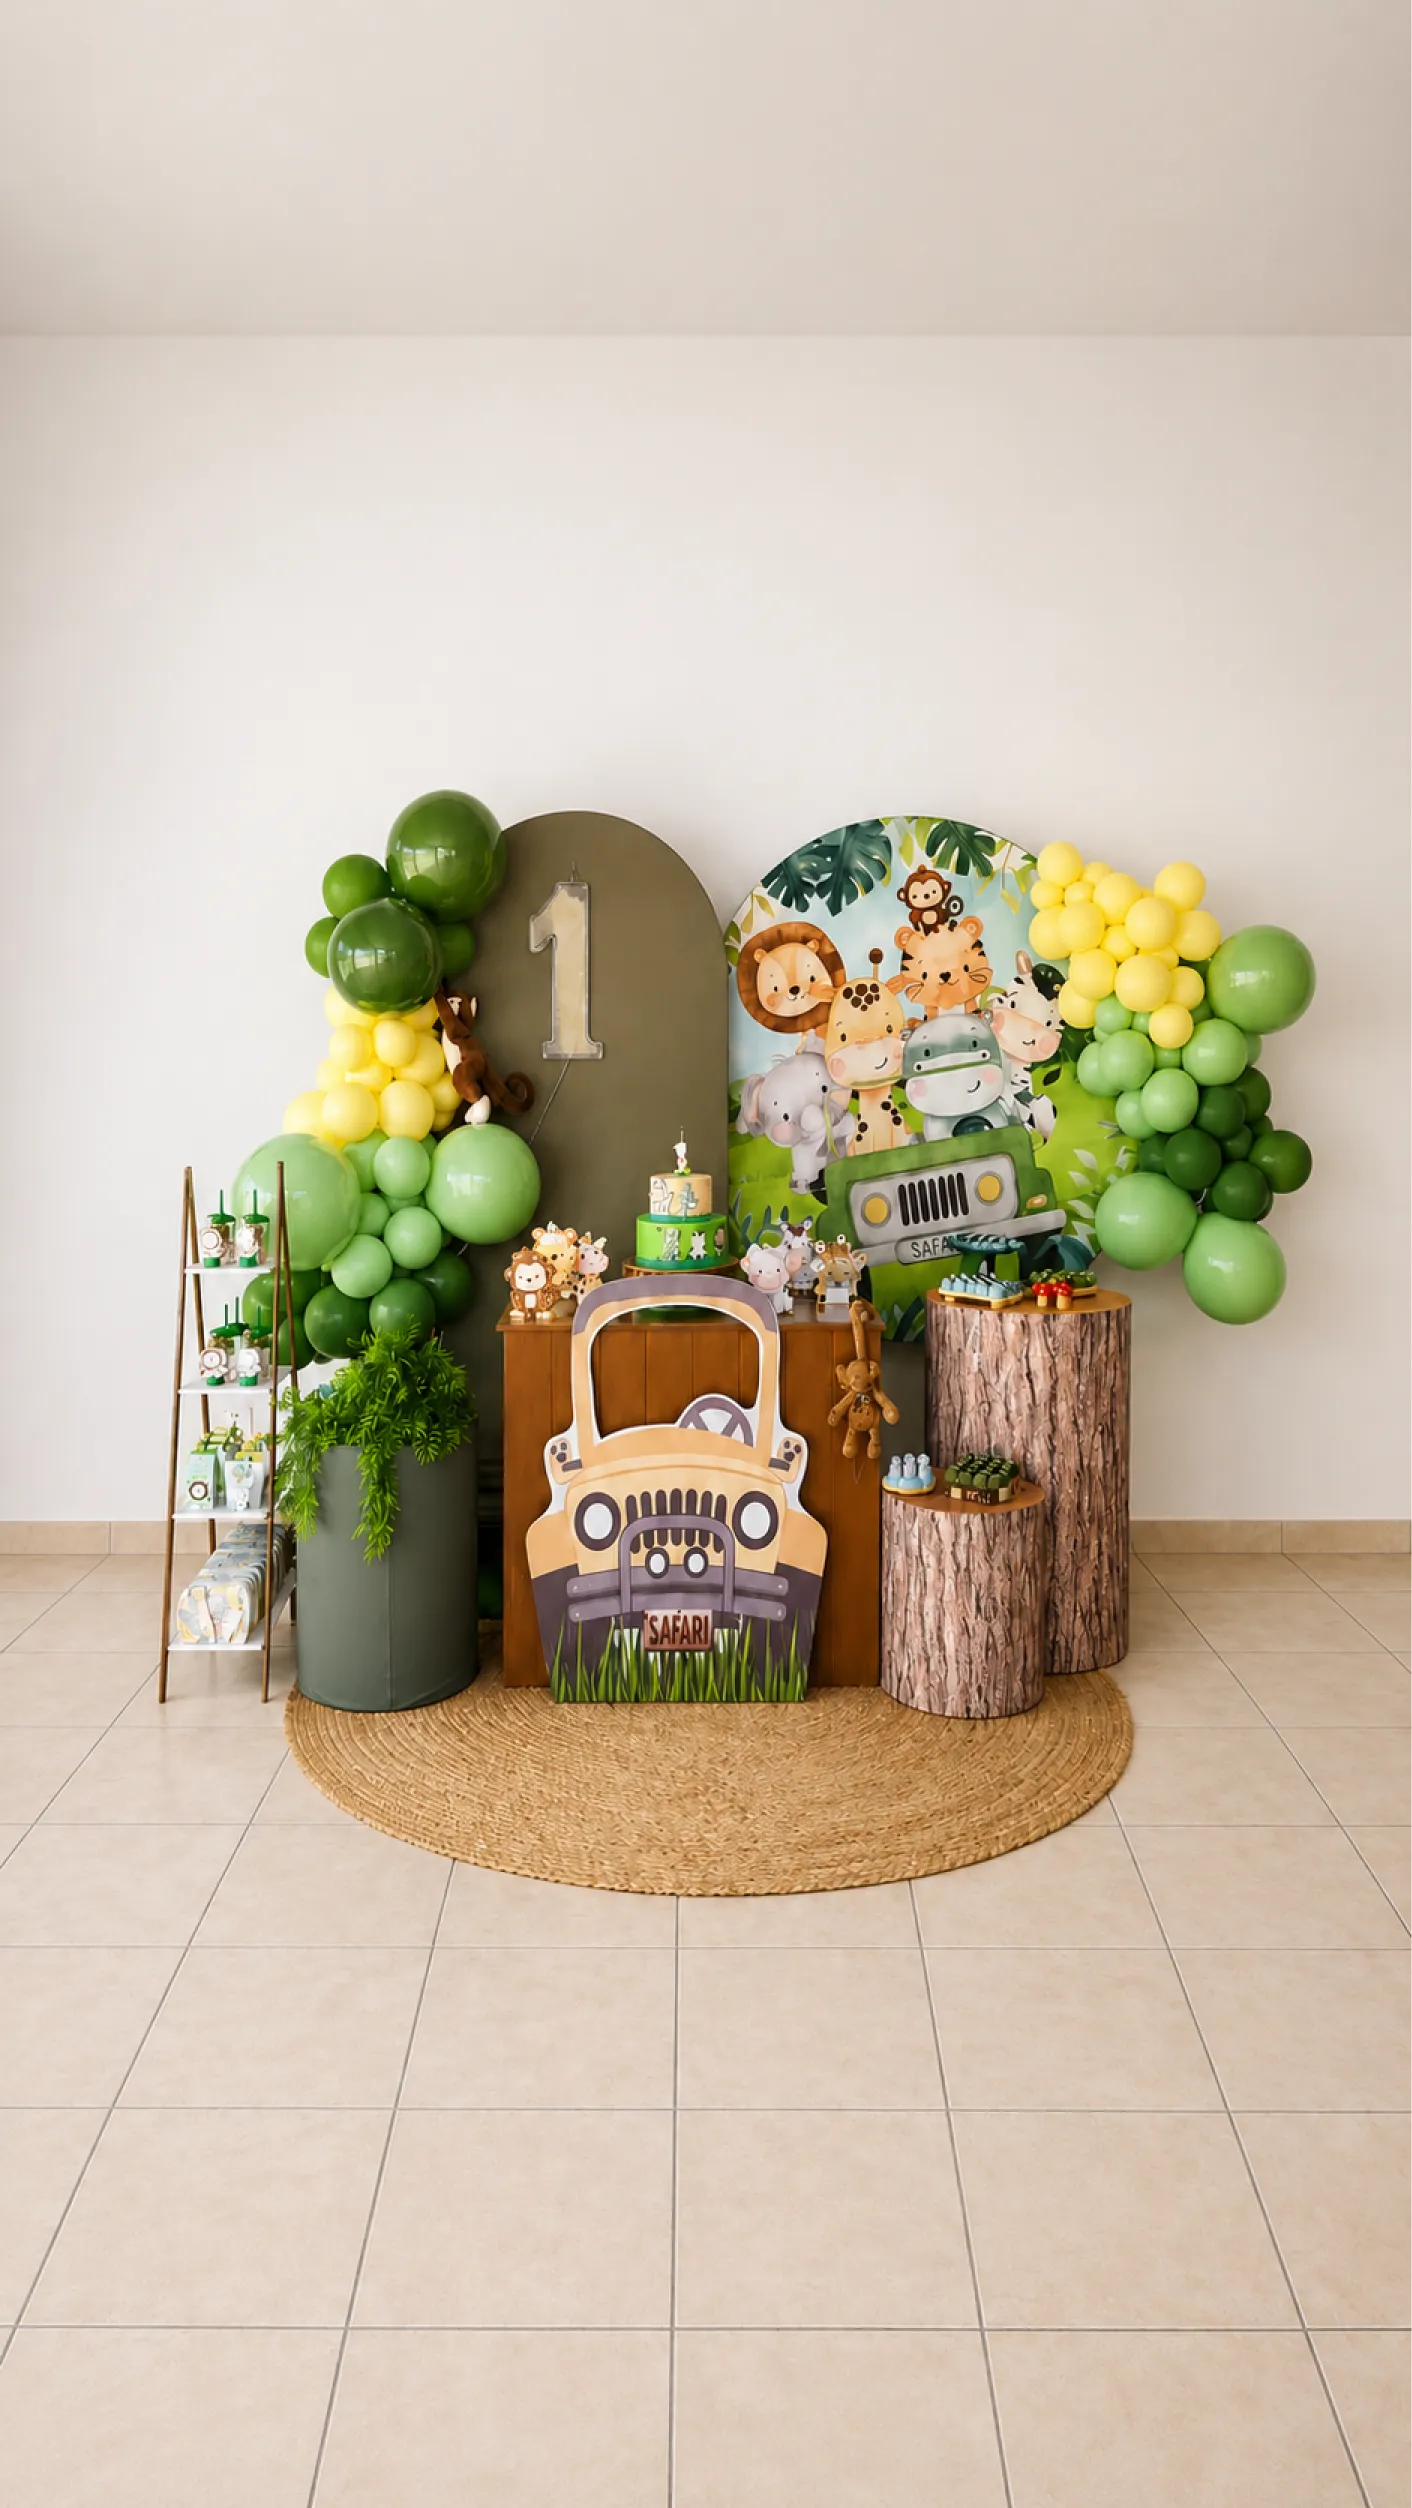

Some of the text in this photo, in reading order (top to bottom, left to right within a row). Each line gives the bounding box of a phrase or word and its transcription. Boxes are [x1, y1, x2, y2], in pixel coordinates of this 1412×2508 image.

[529, 882, 604, 1060] 1
[911, 1235, 960, 1258] SAFA
[649, 1615, 709, 1645] SAFARI
